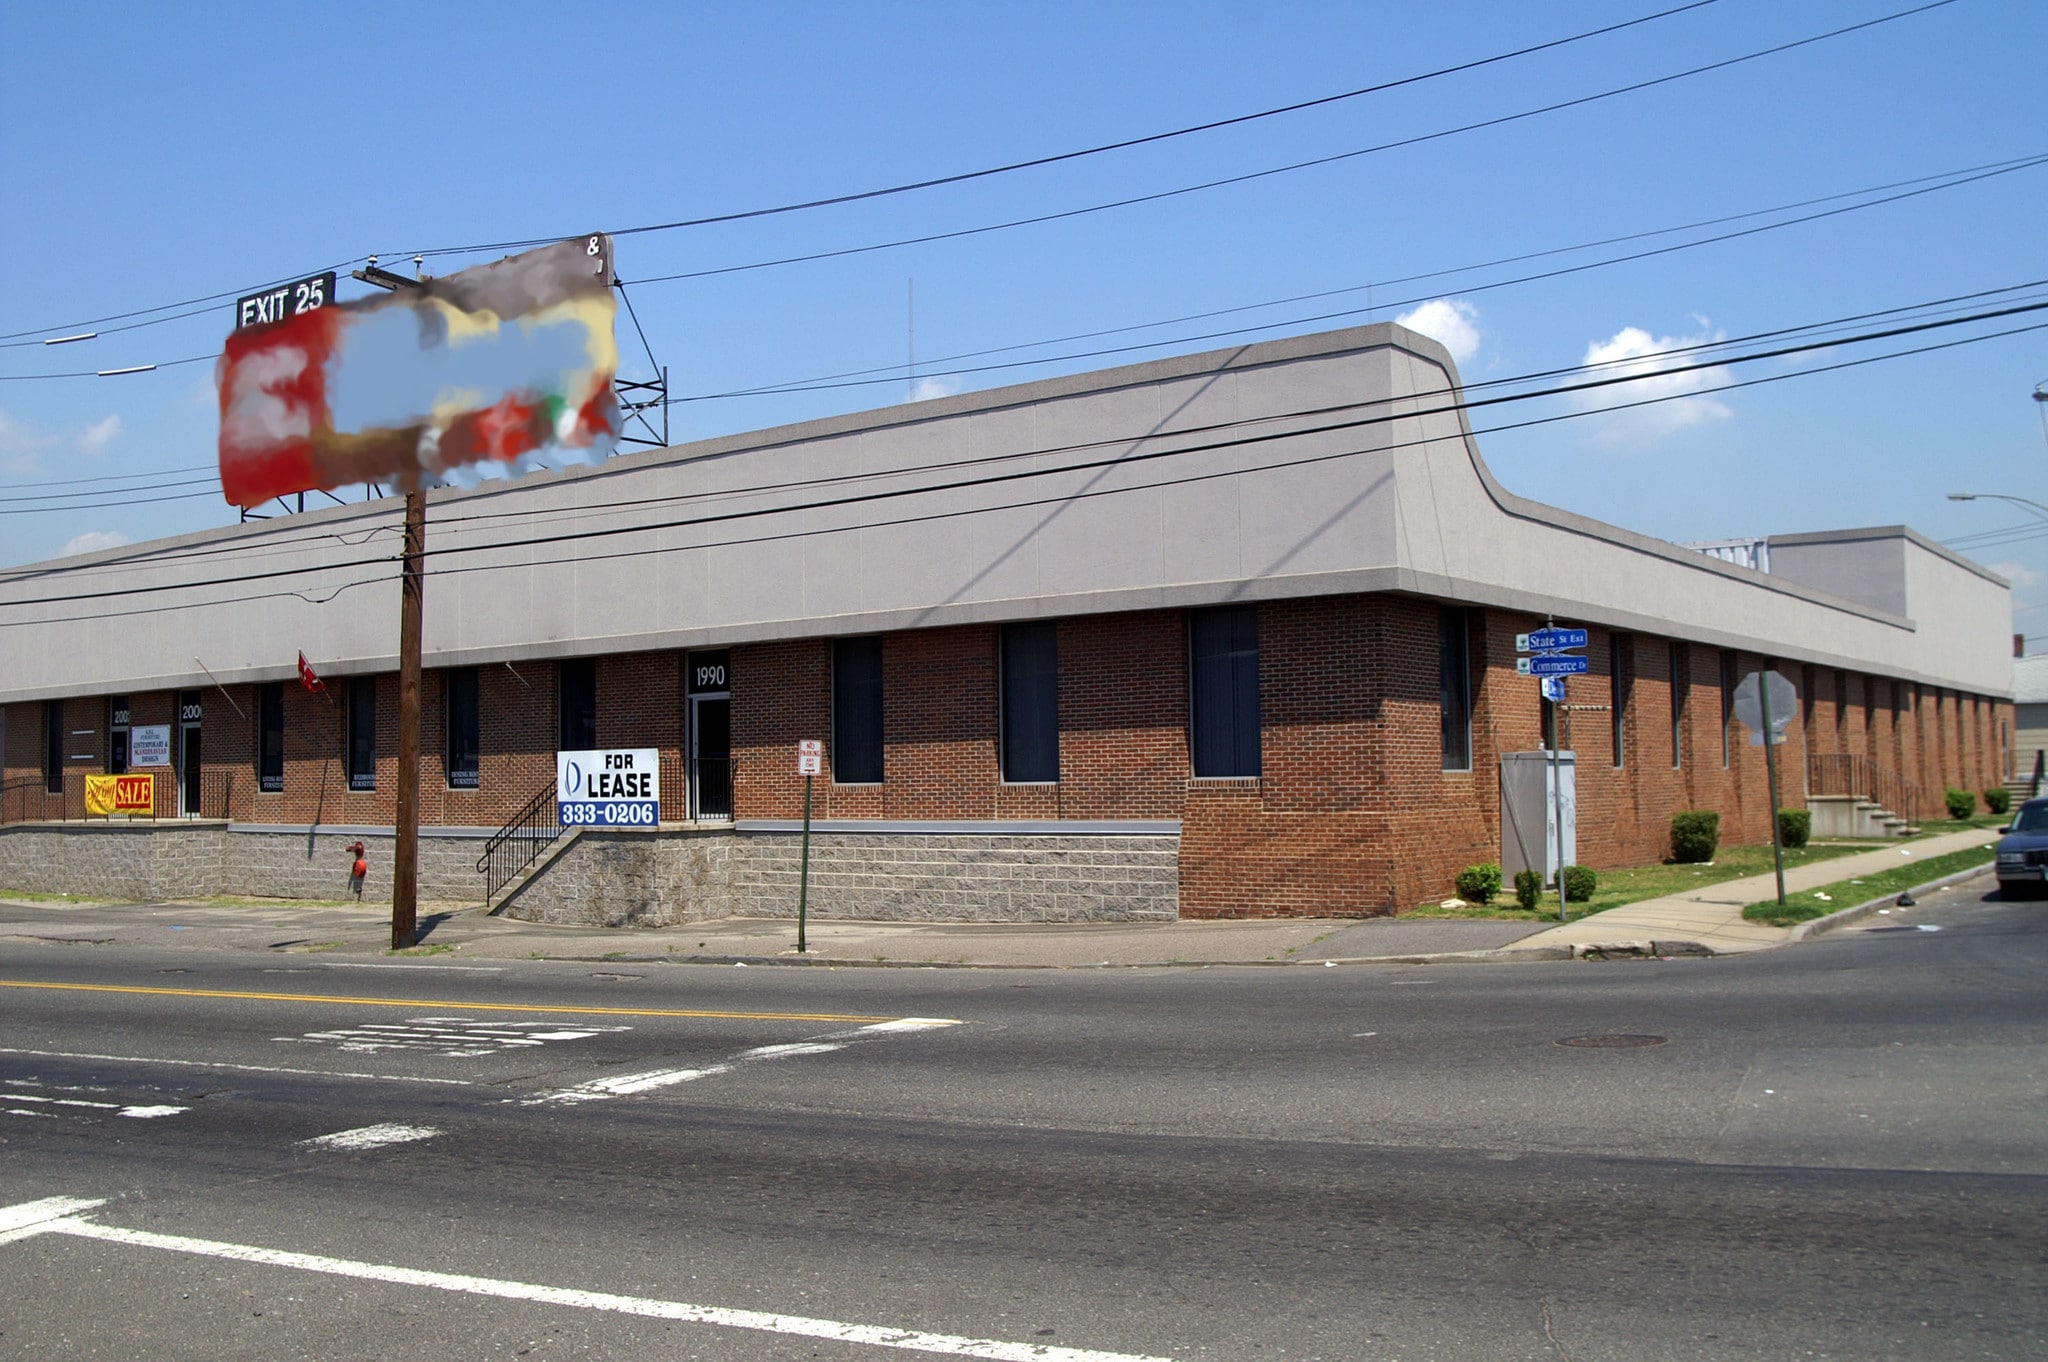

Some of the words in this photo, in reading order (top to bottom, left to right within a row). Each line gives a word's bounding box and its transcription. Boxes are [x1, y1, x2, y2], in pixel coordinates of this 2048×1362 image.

[242, 288, 289, 328] EXIT
[295, 279, 324, 316] 25
[1530, 635, 1555, 648] State
[697, 665, 725, 686] 1990
[1531, 660, 1577, 672] Commerce
[182, 704, 202, 719] 200
[605, 754, 633, 769] FOR
[117, 781, 150, 805] SALE
[588, 773, 651, 798] LEASE
[562, 803, 654, 823] 333-0206
